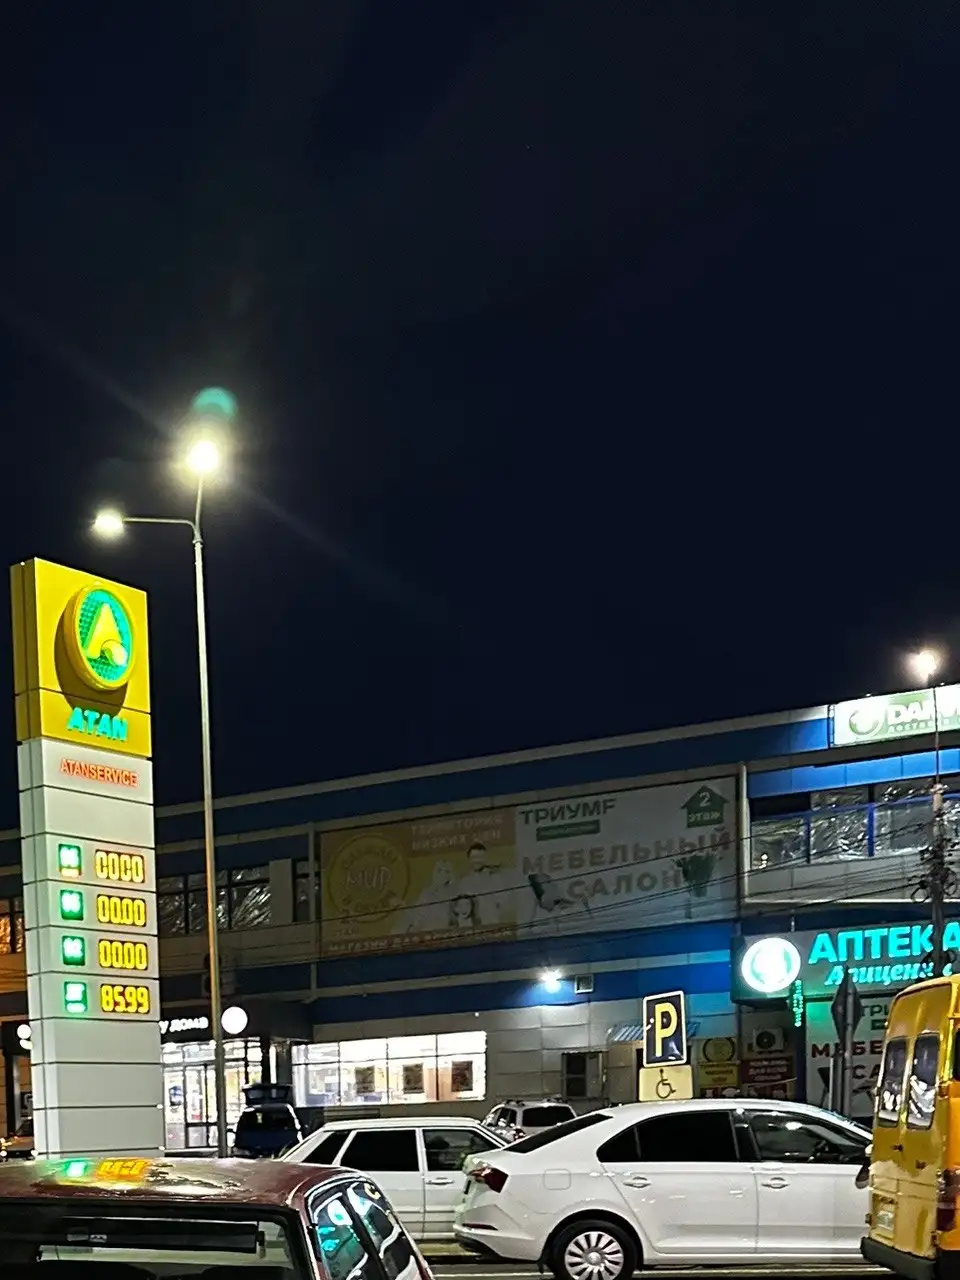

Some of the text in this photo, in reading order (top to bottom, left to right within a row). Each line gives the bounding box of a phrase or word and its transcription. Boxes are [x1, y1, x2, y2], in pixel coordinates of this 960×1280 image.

[67, 706, 128, 742] ATAN
[60, 759, 138, 787] ATANSERVICE
[699, 791, 712, 807] 2
[522, 826, 732, 875] МЕБЕЛЬНЫЙ
[566, 868, 683, 900] САЛОН
[808, 921, 960, 965] АПТЕКА
[655, 1002, 678, 1058] P
